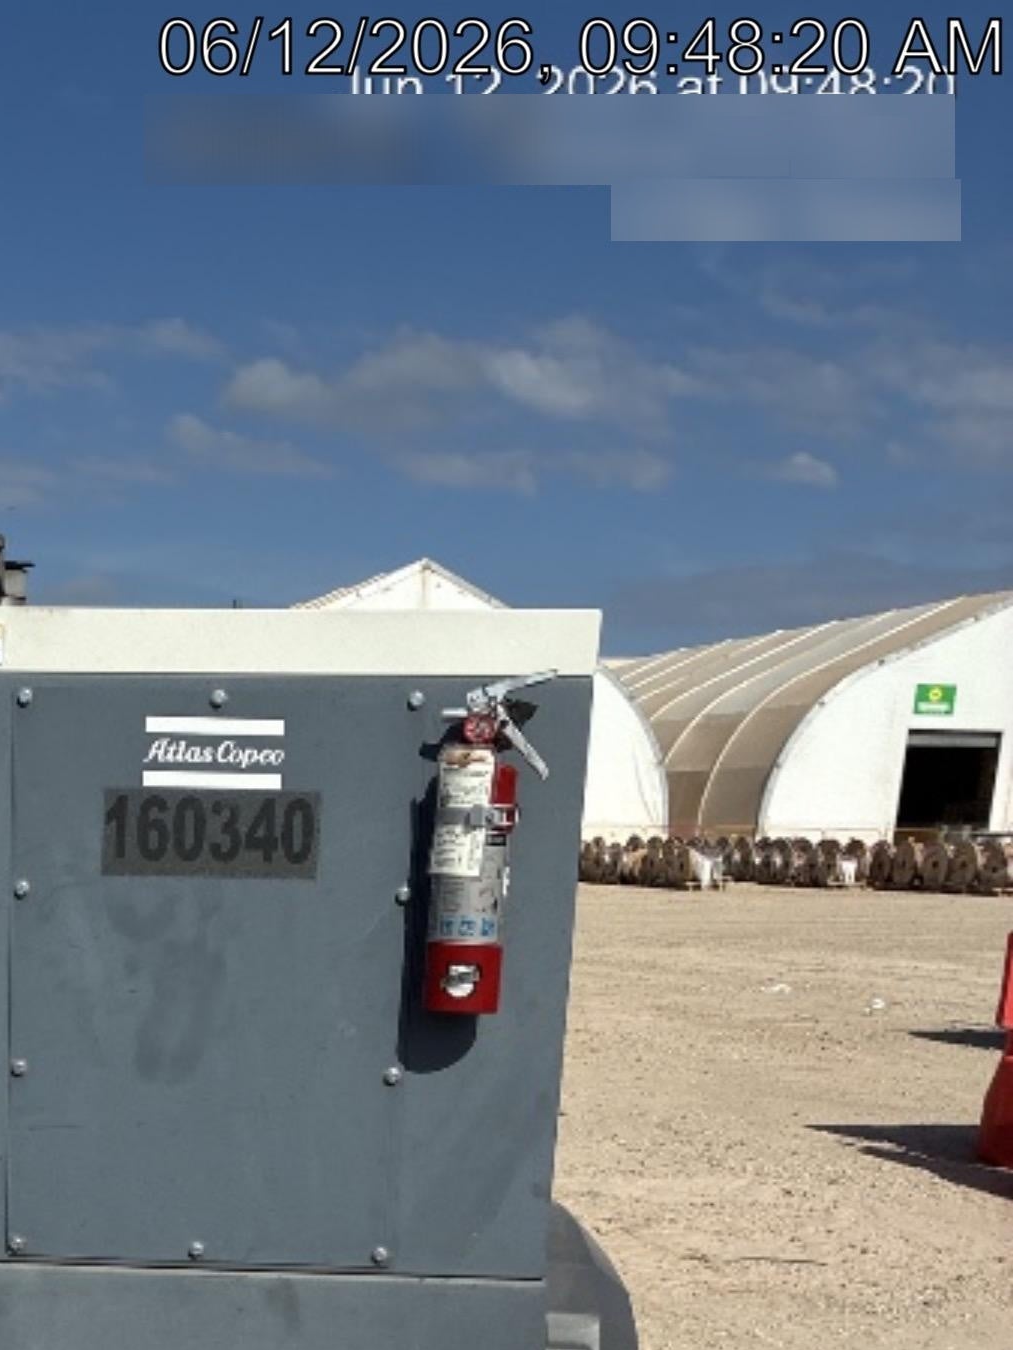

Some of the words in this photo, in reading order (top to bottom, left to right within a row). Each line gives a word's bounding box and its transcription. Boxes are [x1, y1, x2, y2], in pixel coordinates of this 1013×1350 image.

[143, 737, 214, 763] Atlas
[216, 740, 285, 768] Copco
[105, 794, 315, 865] 160340
